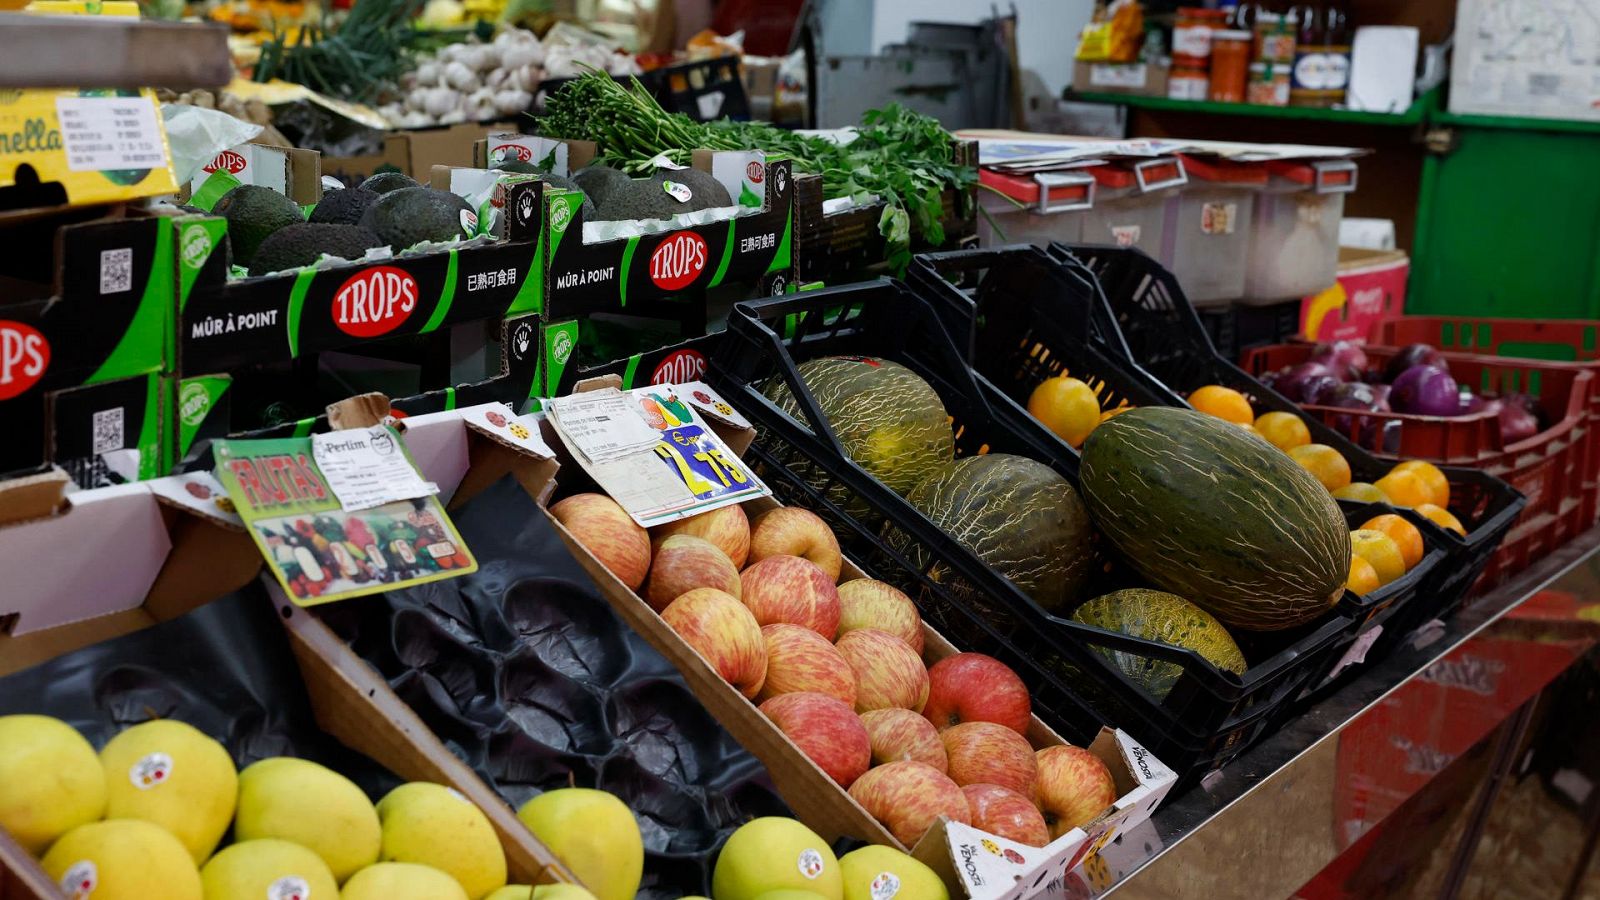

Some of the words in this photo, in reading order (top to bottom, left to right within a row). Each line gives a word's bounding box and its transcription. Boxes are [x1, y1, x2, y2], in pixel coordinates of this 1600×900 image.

[652, 235, 705, 280] TROPS
[741, 233, 775, 253] 已熟可食用
[467, 268, 517, 292] 已熟可食用
[556, 270, 578, 290] MÛR
[579, 269, 586, 285] À
[587, 267, 614, 284] POINT
[336, 271, 416, 324] TROPS
[192, 316, 223, 339] MÛR
[225, 313, 236, 332] À
[238, 310, 278, 331] POINT
[325, 439, 366, 453] Perlim
[231, 453, 327, 507] FRUTAS
[653, 440, 713, 496] 2
[693, 449, 747, 488] 75
[1132, 747, 1152, 780] VENOSTA
[959, 844, 982, 887] VENOSTA
